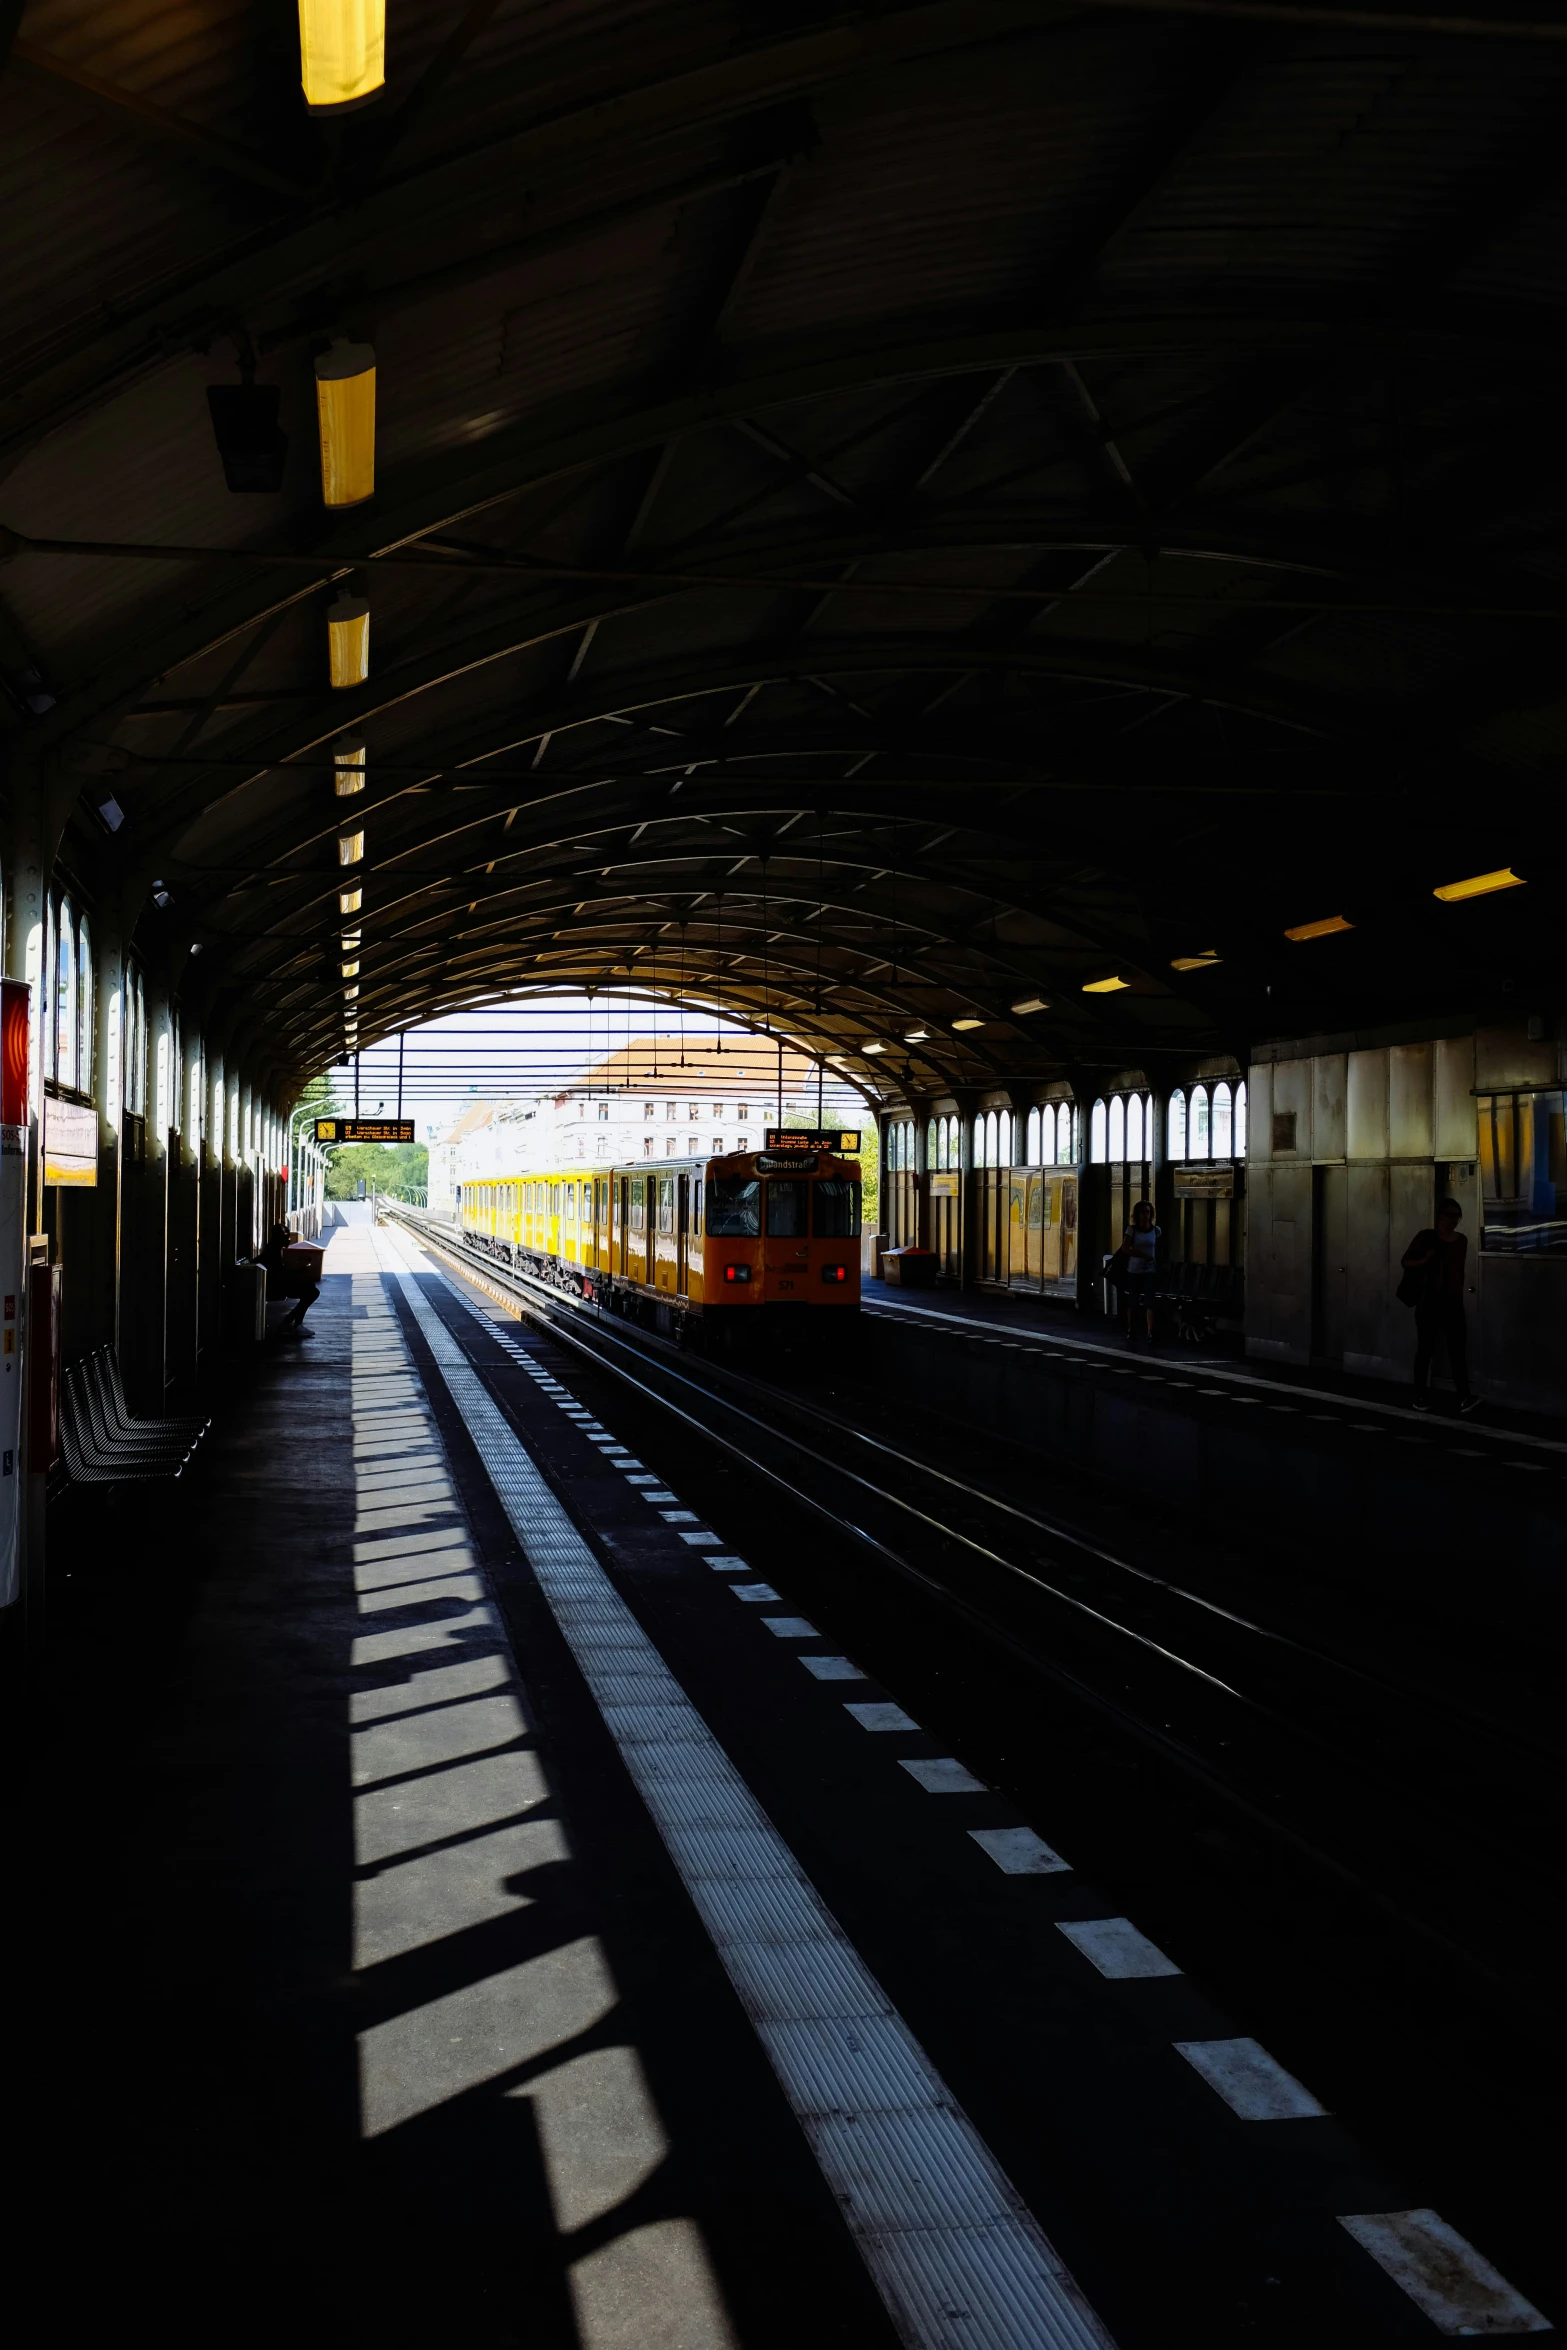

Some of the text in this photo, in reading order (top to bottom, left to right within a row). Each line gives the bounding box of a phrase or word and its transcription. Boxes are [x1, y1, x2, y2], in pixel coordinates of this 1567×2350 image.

[760, 1159, 813, 1169] Uandstraß
[595, 1273, 603, 1285] 4
[778, 1280, 794, 1290] 571
[5, 1302, 15, 1312] SOS
